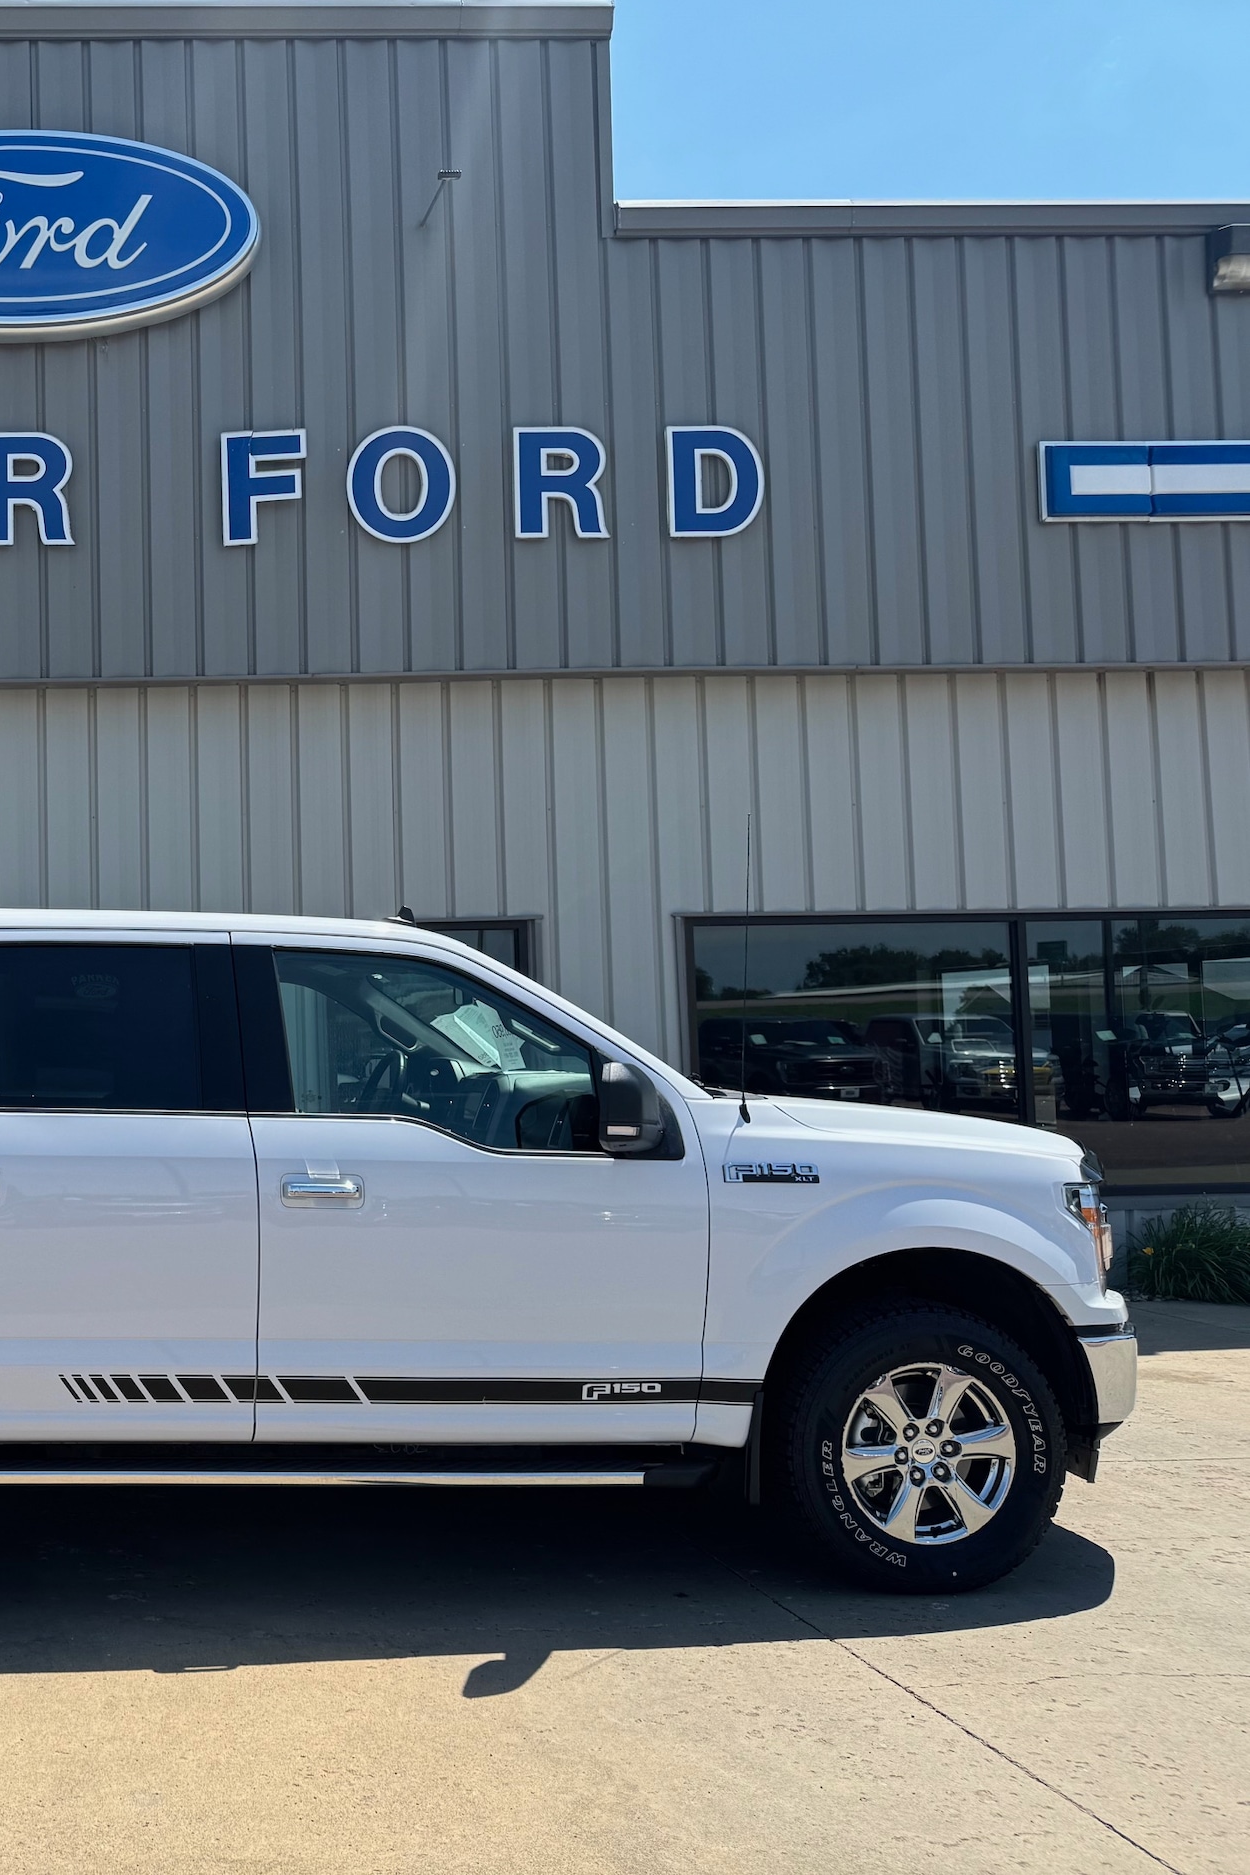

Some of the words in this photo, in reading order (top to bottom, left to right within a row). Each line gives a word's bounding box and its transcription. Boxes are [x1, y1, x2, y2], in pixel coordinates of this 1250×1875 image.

[220, 425, 766, 547] FORD
[722, 1162, 819, 1183] F150
[581, 1383, 662, 1400] F150
[957, 1344, 1047, 1474] GOODYEAR
[821, 1440, 907, 1567] WRANGLER
